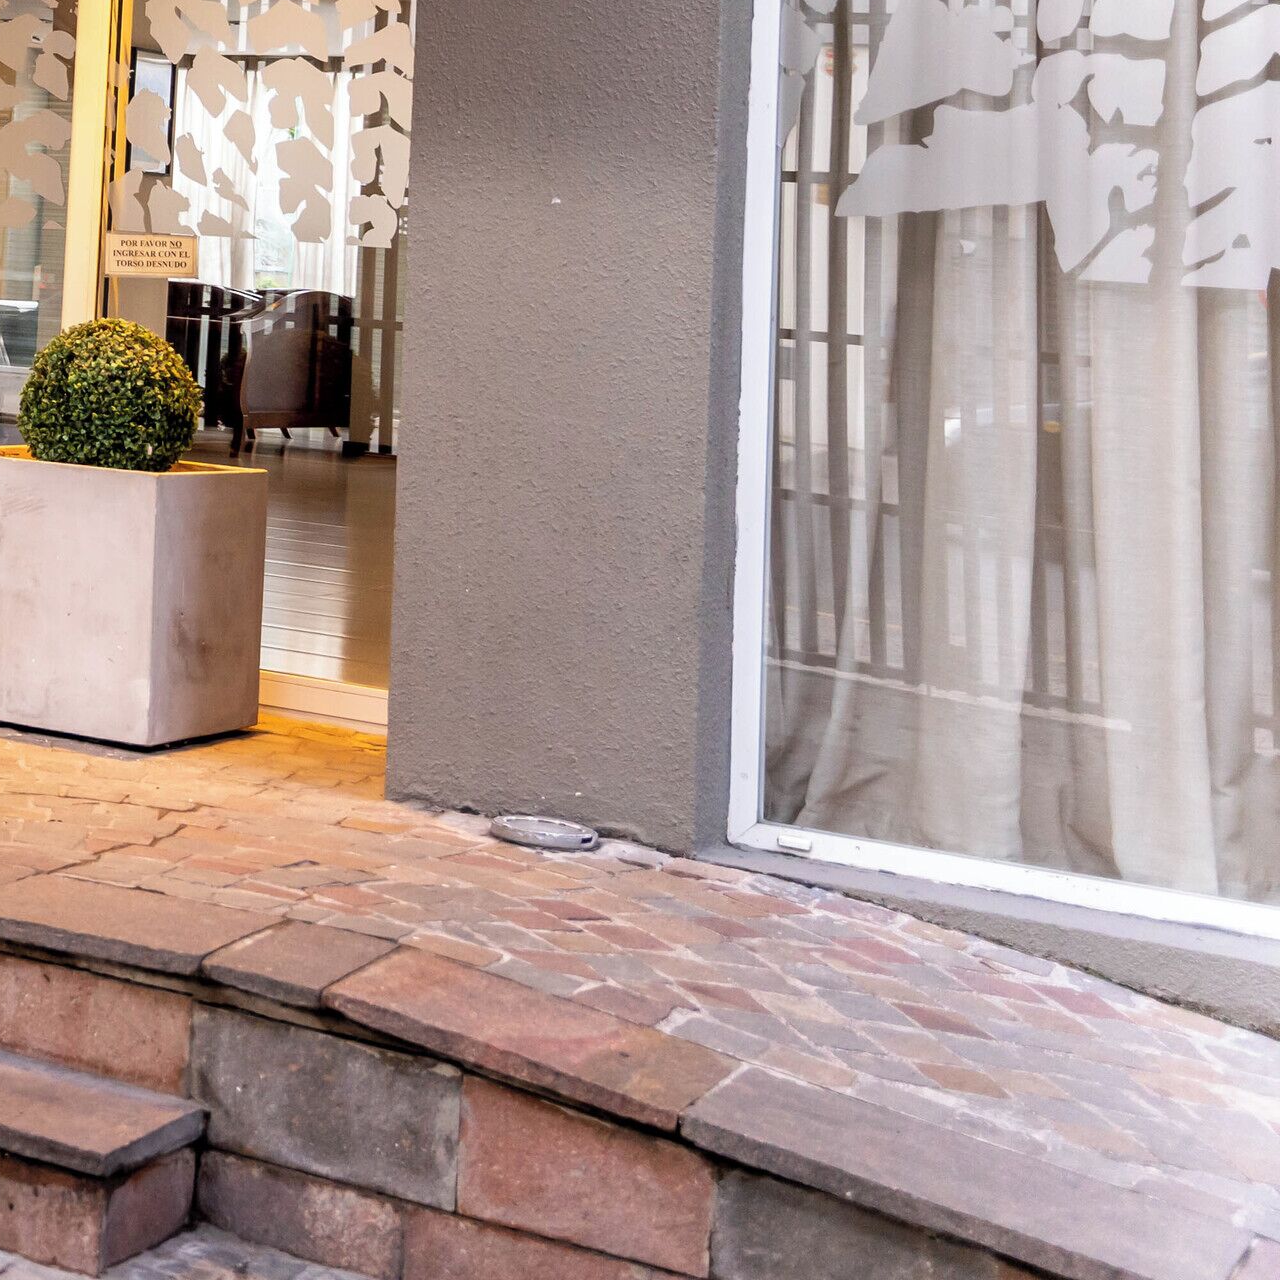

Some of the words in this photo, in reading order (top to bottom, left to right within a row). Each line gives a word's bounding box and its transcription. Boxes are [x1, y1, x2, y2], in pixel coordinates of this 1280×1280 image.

[120, 239, 138, 247] POR
[140, 239, 167, 248] FAVOR
[169, 240, 183, 248] NO
[113, 249, 156, 258] INGRESAR
[158, 250, 177, 258] CON
[116, 259, 144, 268] TORSO
[146, 260, 187, 269] DESNUDO
